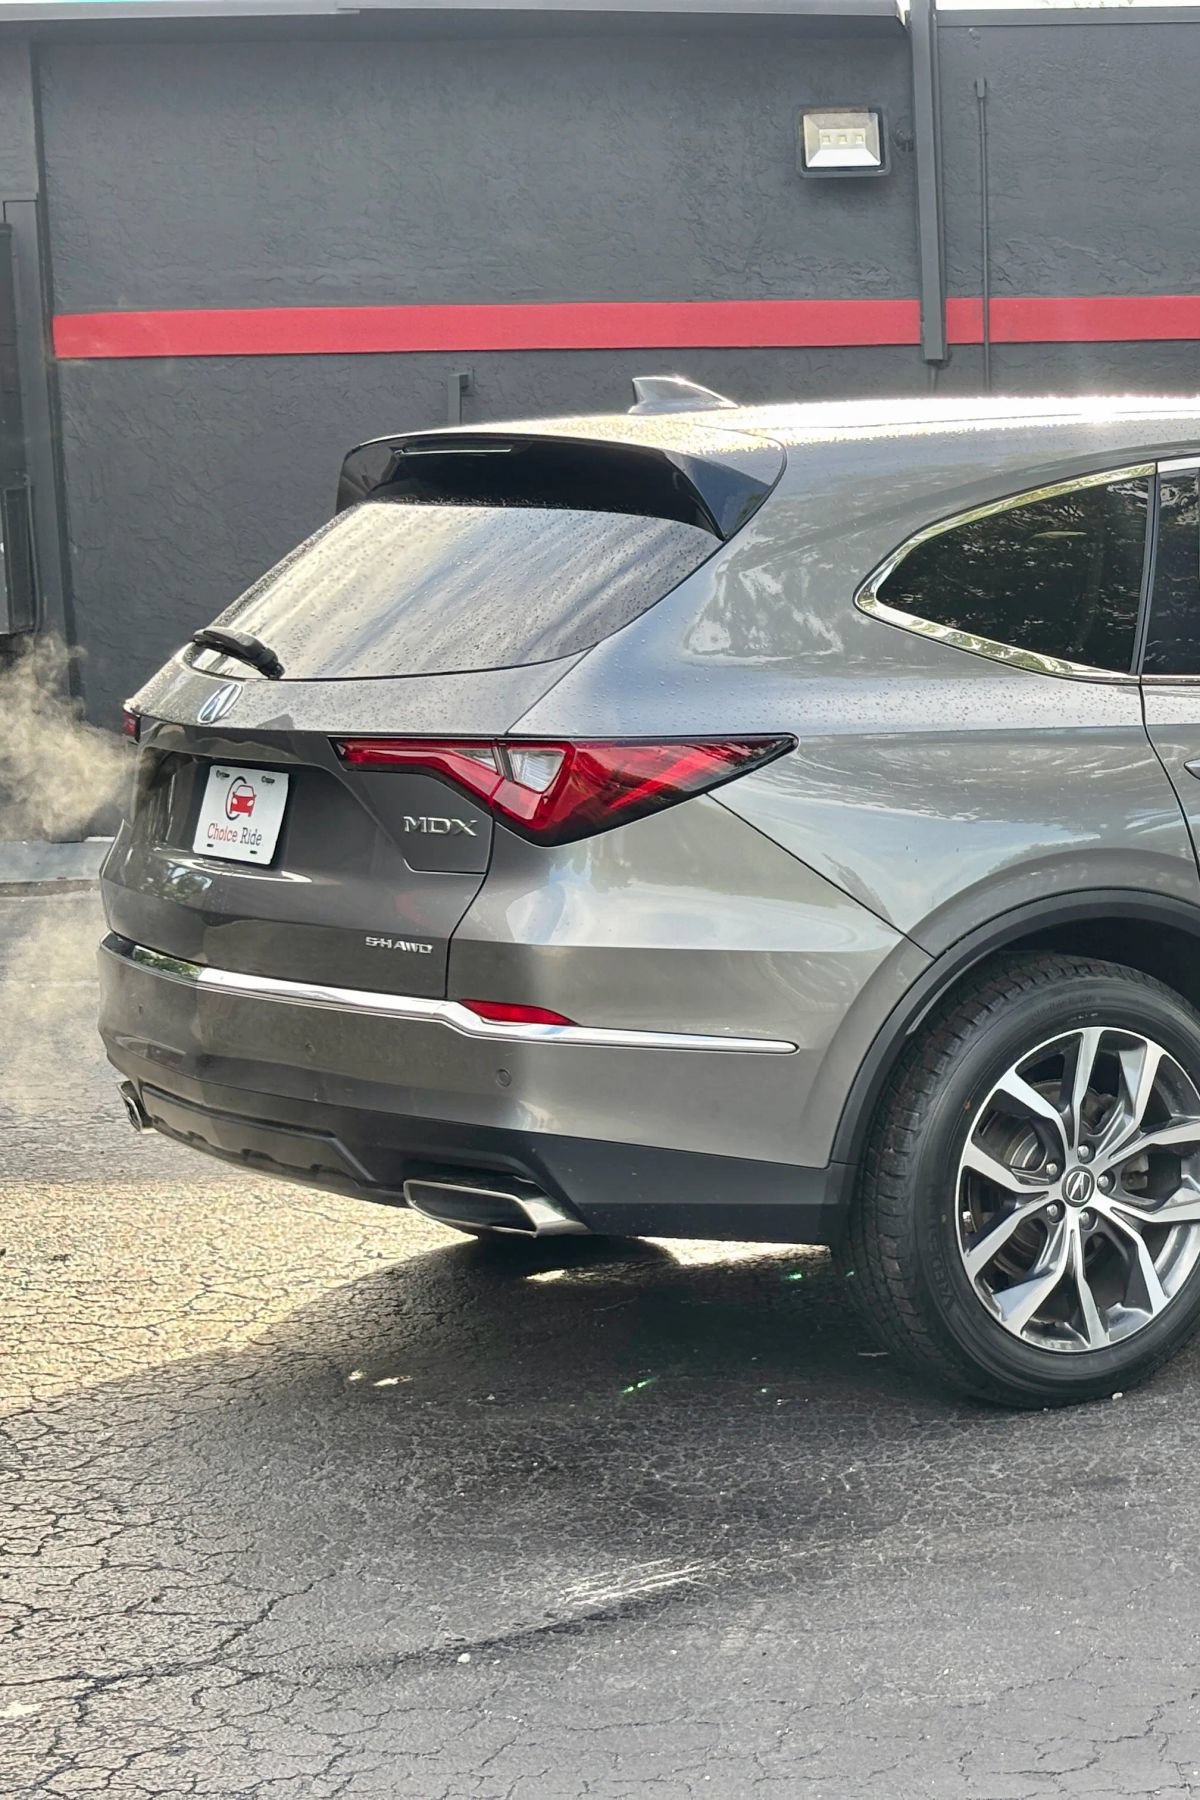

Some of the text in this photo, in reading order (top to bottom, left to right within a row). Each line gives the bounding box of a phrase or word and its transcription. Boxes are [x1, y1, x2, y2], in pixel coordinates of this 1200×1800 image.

[207, 822, 262, 846] Choice Ride
[403, 816, 478, 837] MDX
